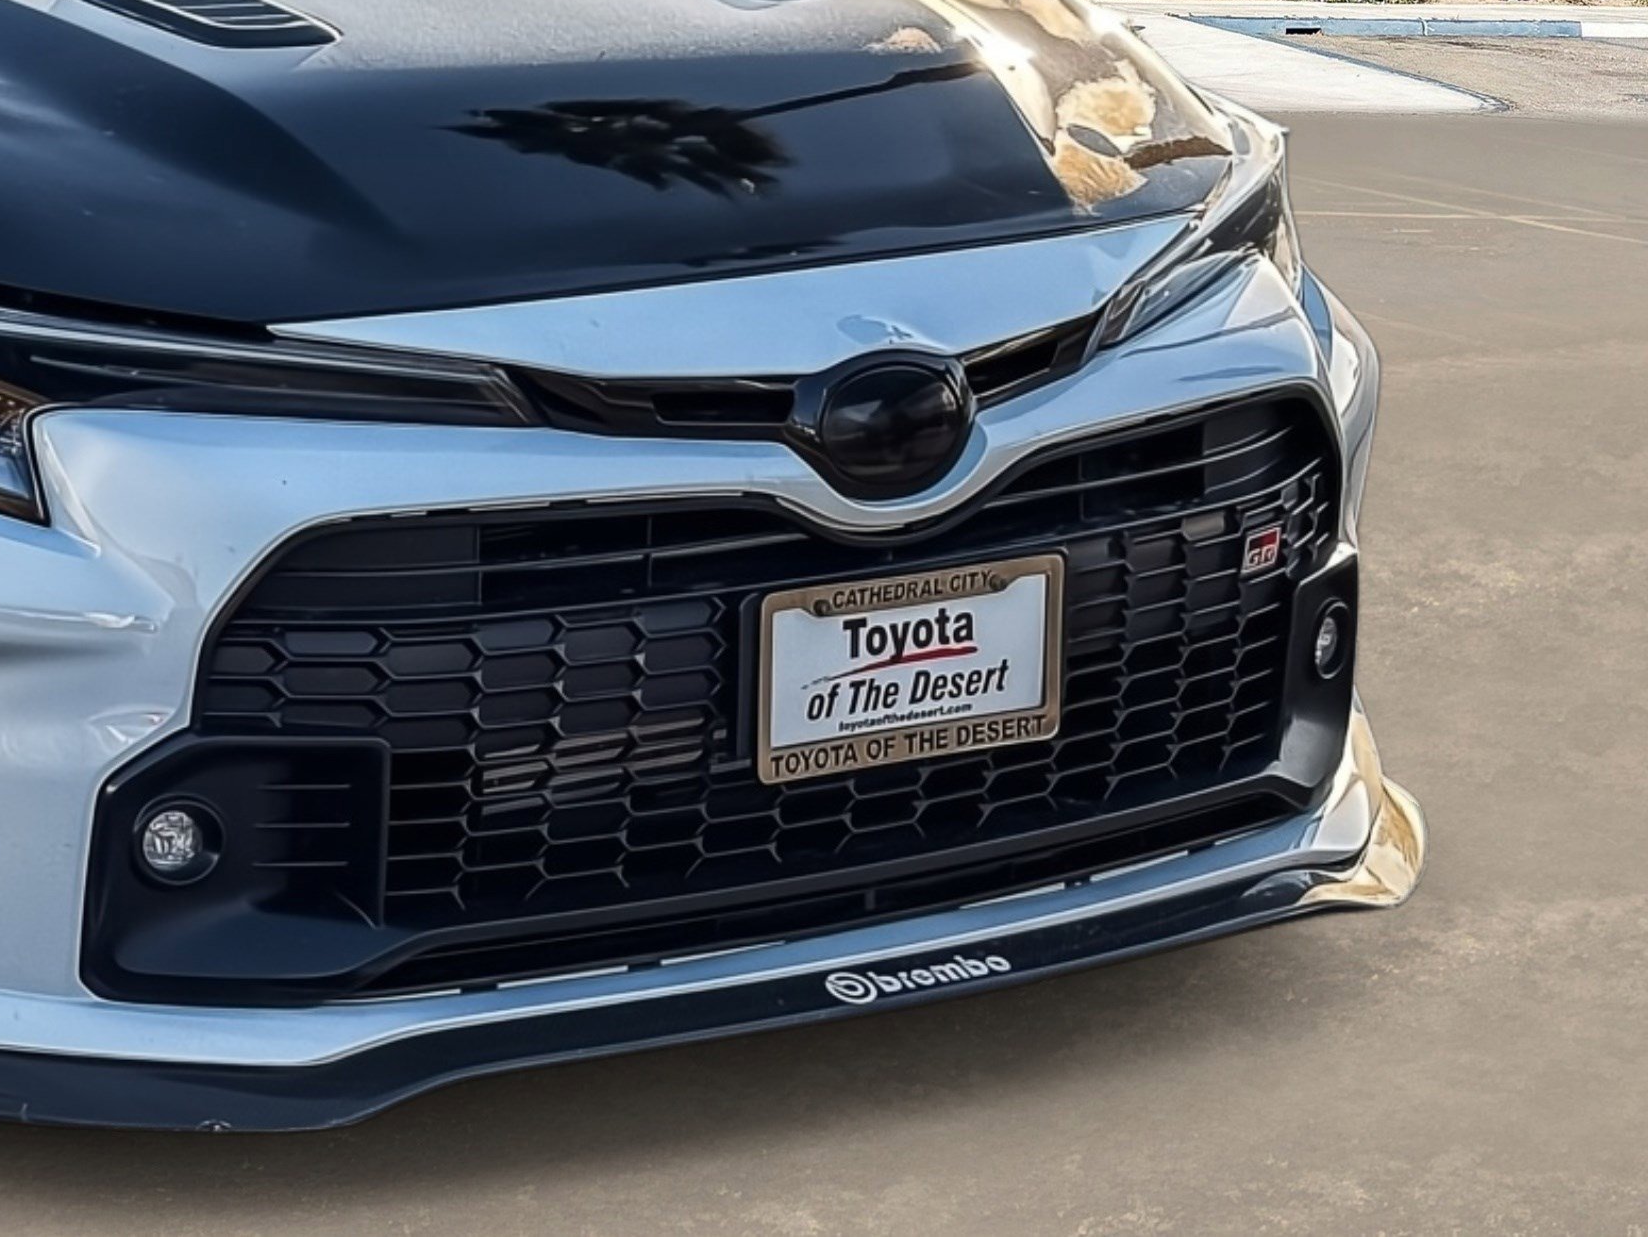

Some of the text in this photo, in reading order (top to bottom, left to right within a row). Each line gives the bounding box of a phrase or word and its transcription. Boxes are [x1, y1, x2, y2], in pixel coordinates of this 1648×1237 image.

[832, 570, 992, 609] CATHEDRAL CITY
[842, 608, 974, 660] Toyota
[807, 659, 1009, 721] of The Desert
[770, 714, 1046, 777] TOYOTA OF THE DESERT
[866, 955, 1012, 993] brembo
